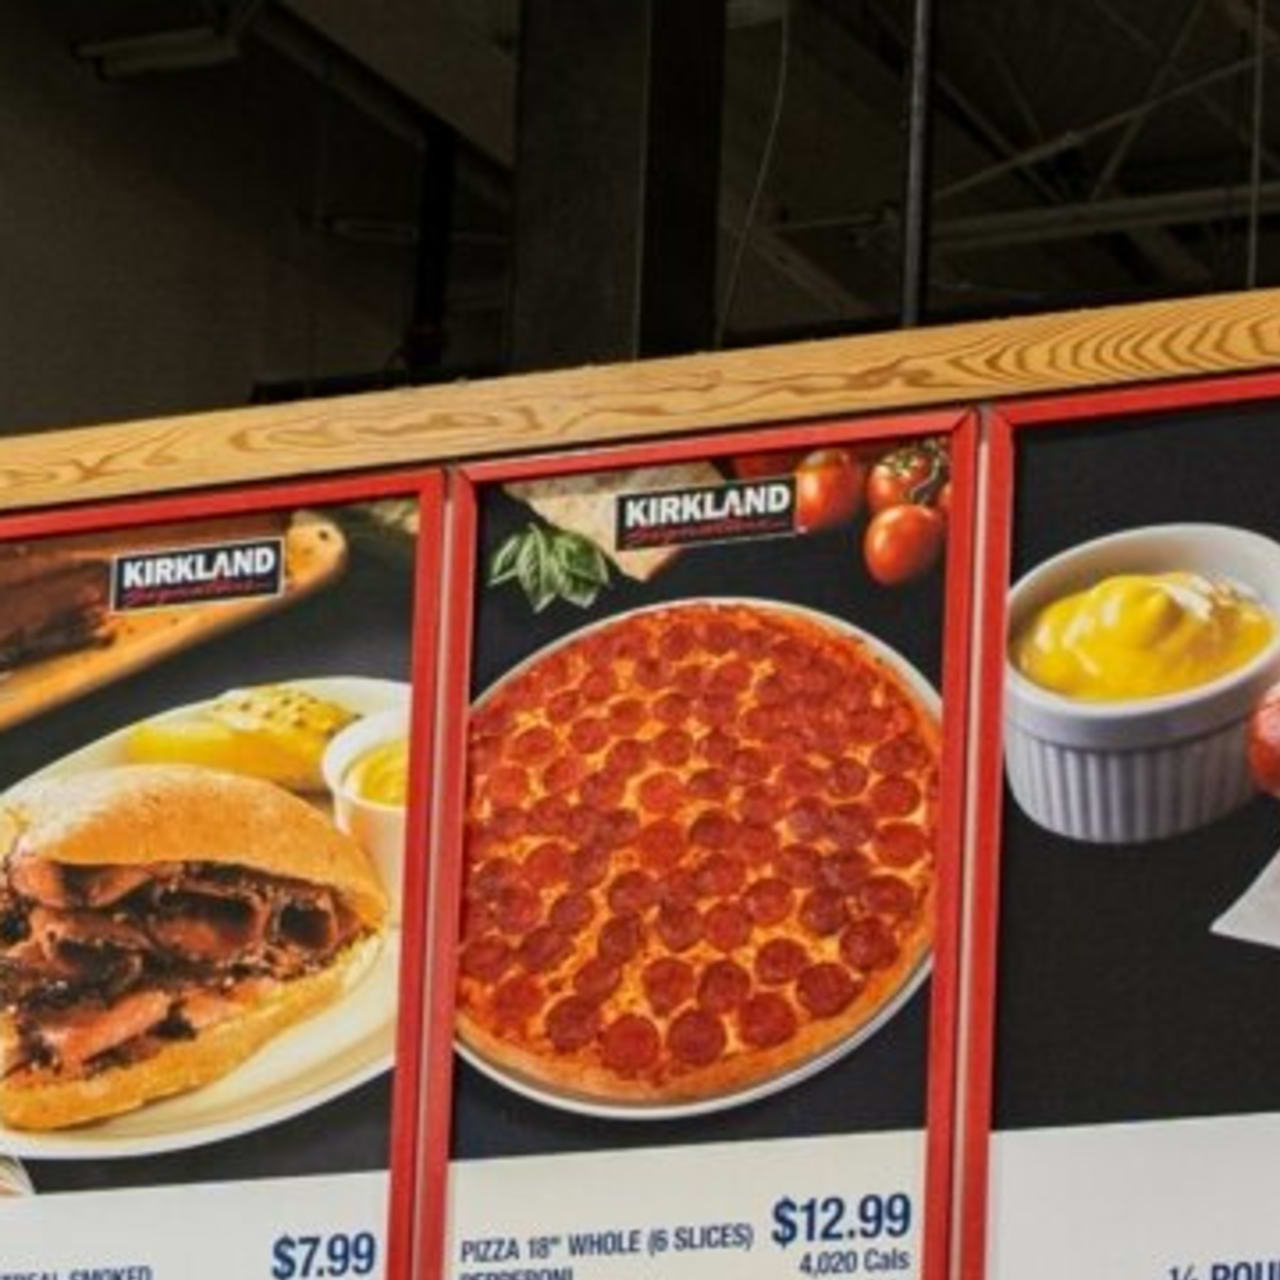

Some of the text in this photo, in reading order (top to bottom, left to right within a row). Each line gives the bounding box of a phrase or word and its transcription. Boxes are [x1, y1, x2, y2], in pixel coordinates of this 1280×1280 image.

[625, 484, 790, 527] KIRKLAND
[123, 547, 275, 588] KIRKLAND
[771, 1193, 911, 1250] $12.99
[460, 1237, 520, 1263] PIZZA
[568, 1231, 641, 1257] WHOLE
[674, 1222, 755, 1251] SLICES)
[863, 1247, 910, 1272] Cals
